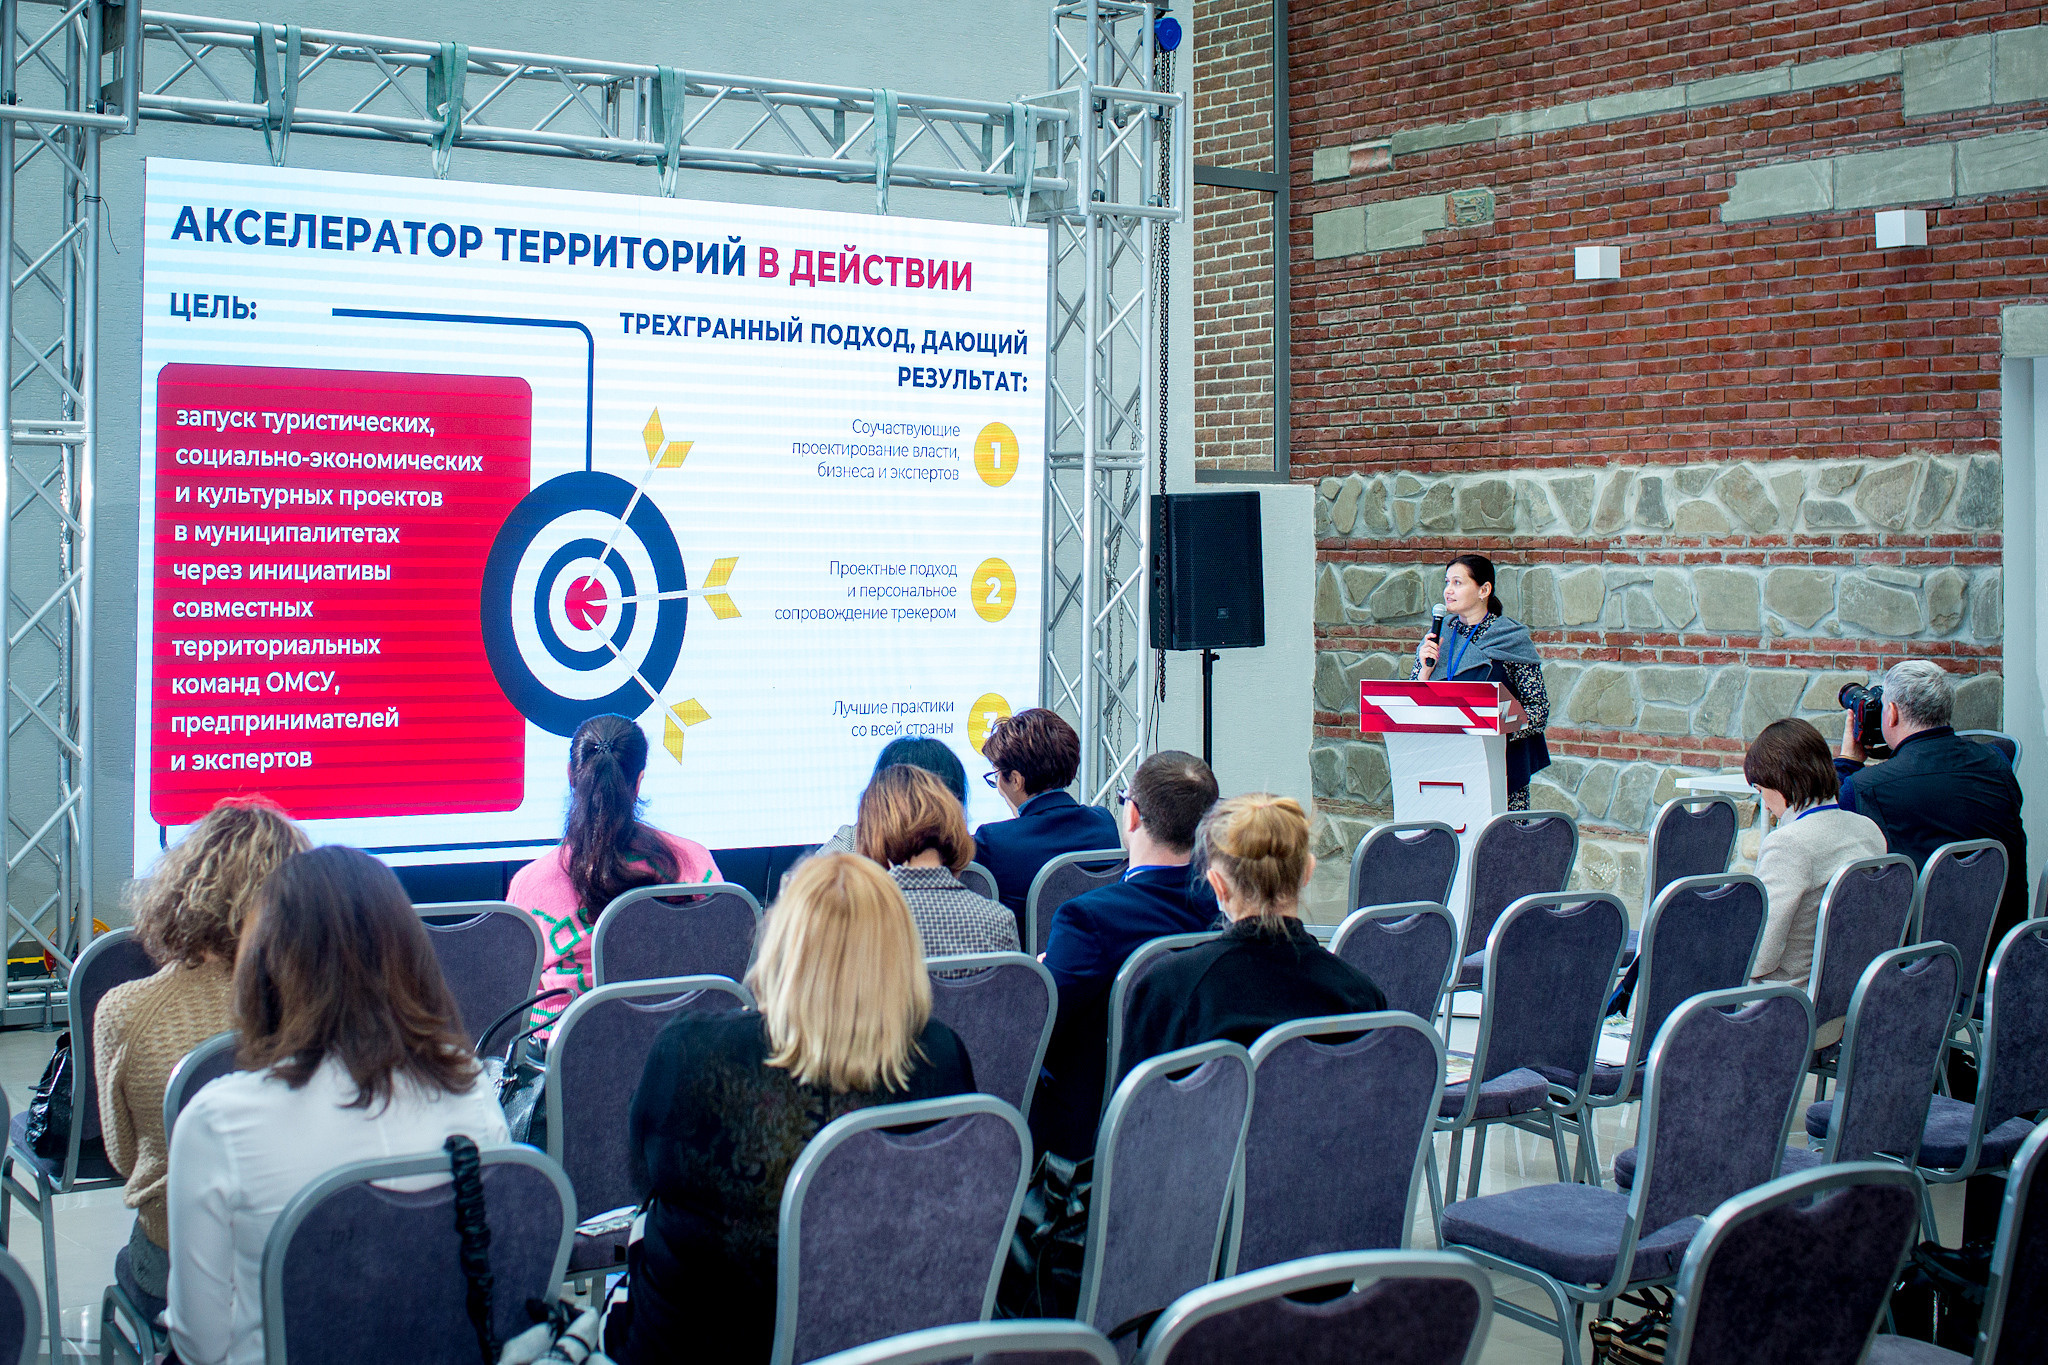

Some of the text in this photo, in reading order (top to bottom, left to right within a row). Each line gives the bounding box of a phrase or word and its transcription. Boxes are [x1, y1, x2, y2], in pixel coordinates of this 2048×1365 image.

[171, 205, 972, 291] АКСЕЛЕРАТОР ТЕРРИТОРИЙ В ДЕЙСТВИИ
[171, 292, 257, 321] ЦЕЛЬ:
[620, 313, 1028, 357] ТРЕХГРАННЫЙ ПОДХОД, ДАЮЩИЙ
[899, 366, 1028, 392] РЕЗУЛЬТАТ:
[176, 409, 435, 437] запуск туристических,
[852, 419, 960, 438] Соучаствующие
[175, 448, 483, 472] социально-экономических
[792, 442, 960, 461] проектирование власти,
[990, 442, 1001, 469] 1
[817, 461, 959, 482] бизнеса и экспертов
[175, 486, 443, 510] и культурных проектов
[174, 524, 400, 546] в муниципалитетах
[173, 563, 391, 585] через инициативы
[830, 561, 957, 578] Проектные подход
[847, 584, 957, 600] и персональное
[985, 577, 1002, 604] 2
[172, 601, 313, 618] совместных
[775, 607, 956, 622] сопровождение трекером
[172, 637, 381, 661] территориальных
[172, 671, 340, 696] команд ОМСУ,
[832, 700, 954, 718] Лучшие практики
[171, 706, 399, 736] предпринимателей
[851, 721, 953, 737] со всей страны
[170, 750, 312, 773] и экспертов
